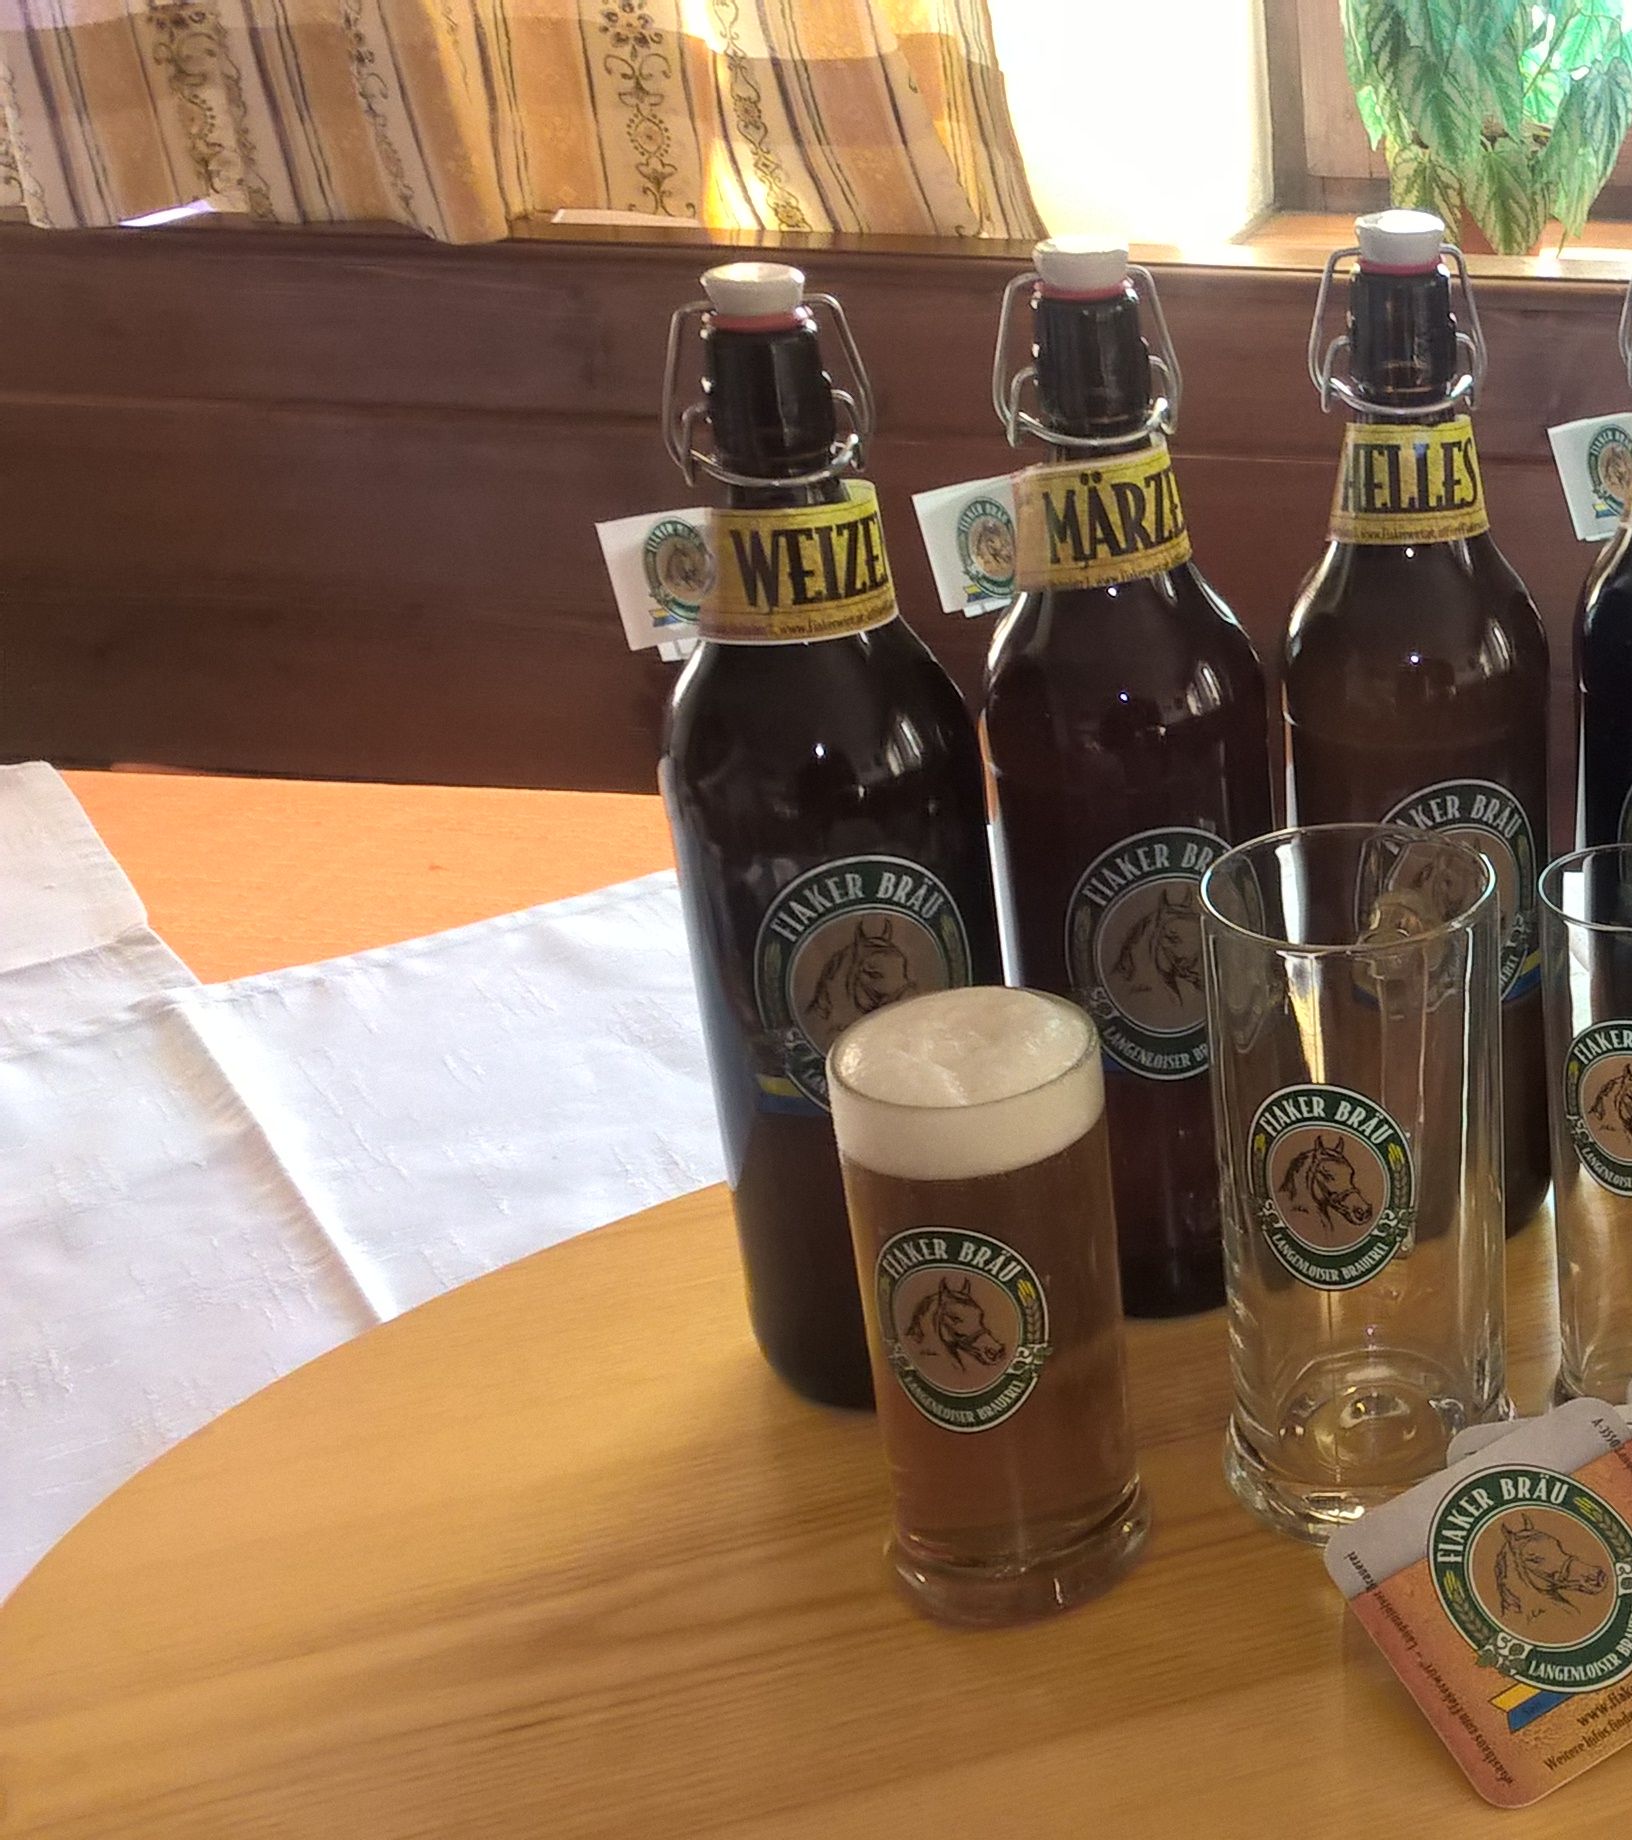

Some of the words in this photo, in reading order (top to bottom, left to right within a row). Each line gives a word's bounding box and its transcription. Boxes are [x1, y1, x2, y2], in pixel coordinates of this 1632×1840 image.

[1341, 437, 1478, 514] HELLES
[1470, 795, 1523, 839] BRÄU
[1082, 843, 1171, 907] FIAKER
[769, 873, 866, 943] FIAKER
[876, 866, 945, 920] BRÄU
[1259, 1096, 1326, 1137] FIAKER
[1334, 1101, 1395, 1146] BRÄU
[881, 1238, 949, 1280] FIAKER
[957, 1241, 1023, 1283] BRÄU
[1271, 1233, 1340, 1282] LANGENLOISER
[1341, 1243, 1390, 1280] BRAUEREI
[903, 1376, 976, 1424] LANGENLOISER
[978, 1379, 1027, 1421] BRAUEREI
[1436, 1487, 1495, 1563] FIAKER
[1499, 1474, 1570, 1505] BRÄU
[1343, 1549, 1378, 1593] Brauerei
[1527, 1652, 1623, 1682] LANGENLOISER
[1543, 1740, 1585, 1772] Weitere
